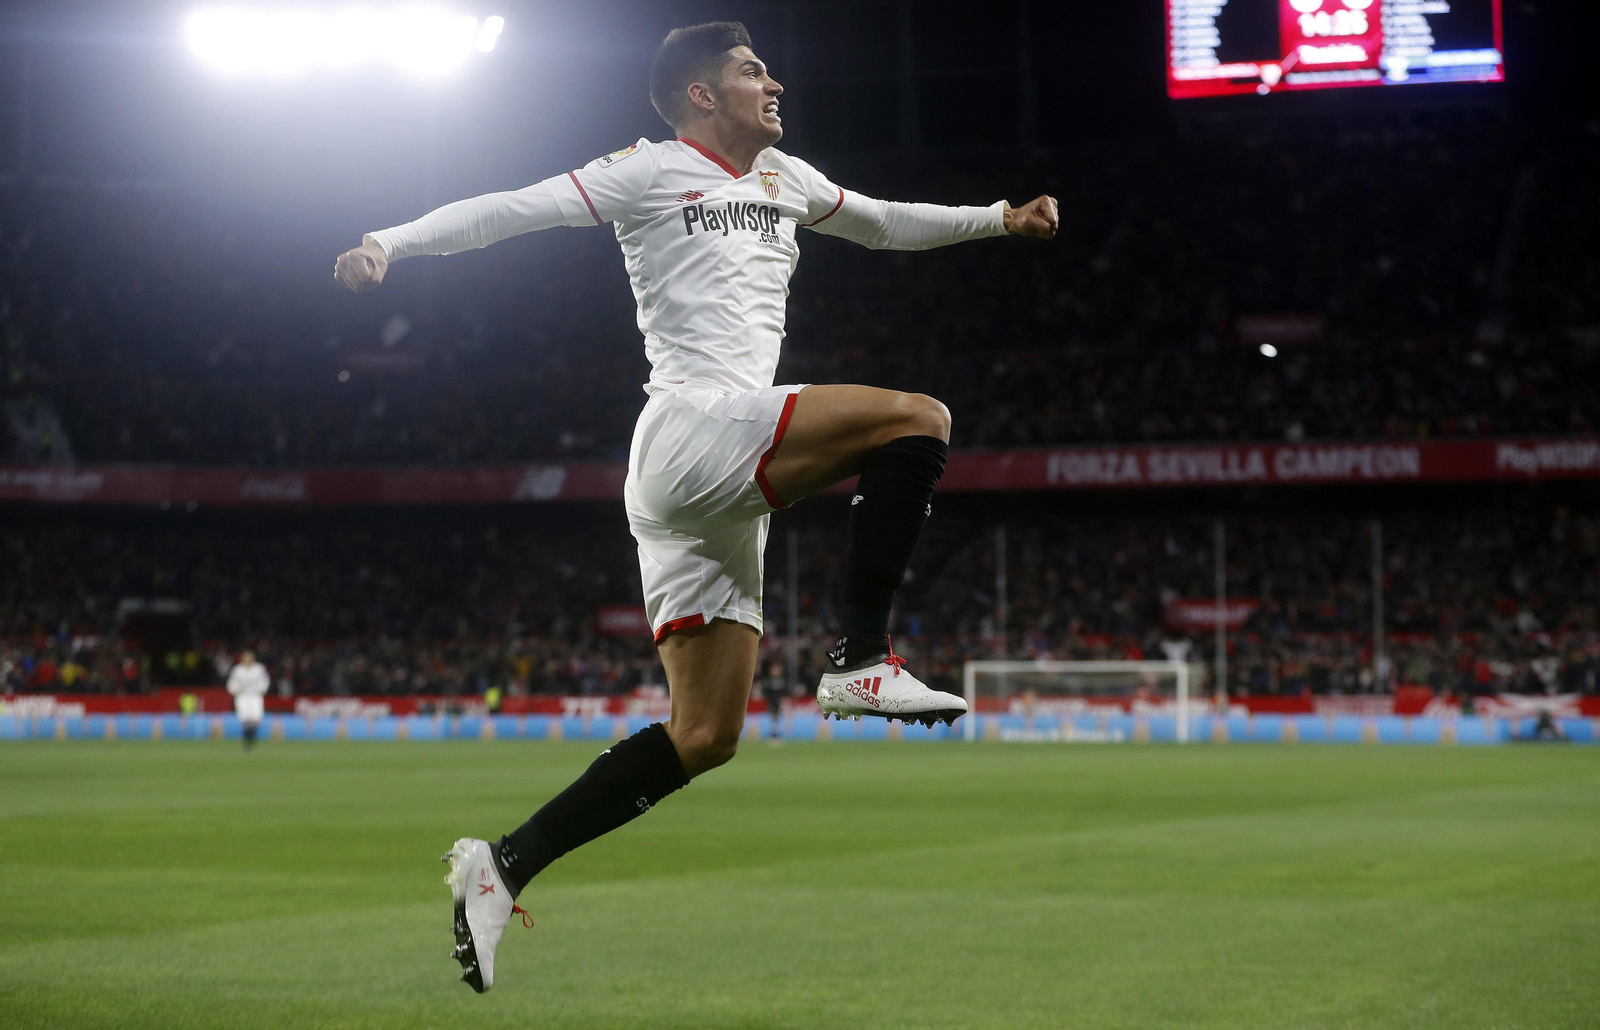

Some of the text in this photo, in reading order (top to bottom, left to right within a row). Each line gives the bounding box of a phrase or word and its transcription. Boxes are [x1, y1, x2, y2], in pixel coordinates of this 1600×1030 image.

[682, 201, 780, 236] PlayWSOP
[759, 233, 781, 245] .com
[1046, 446, 1420, 483] FORZA SEVILLA CAMPEON
[845, 682, 882, 708] adidas
